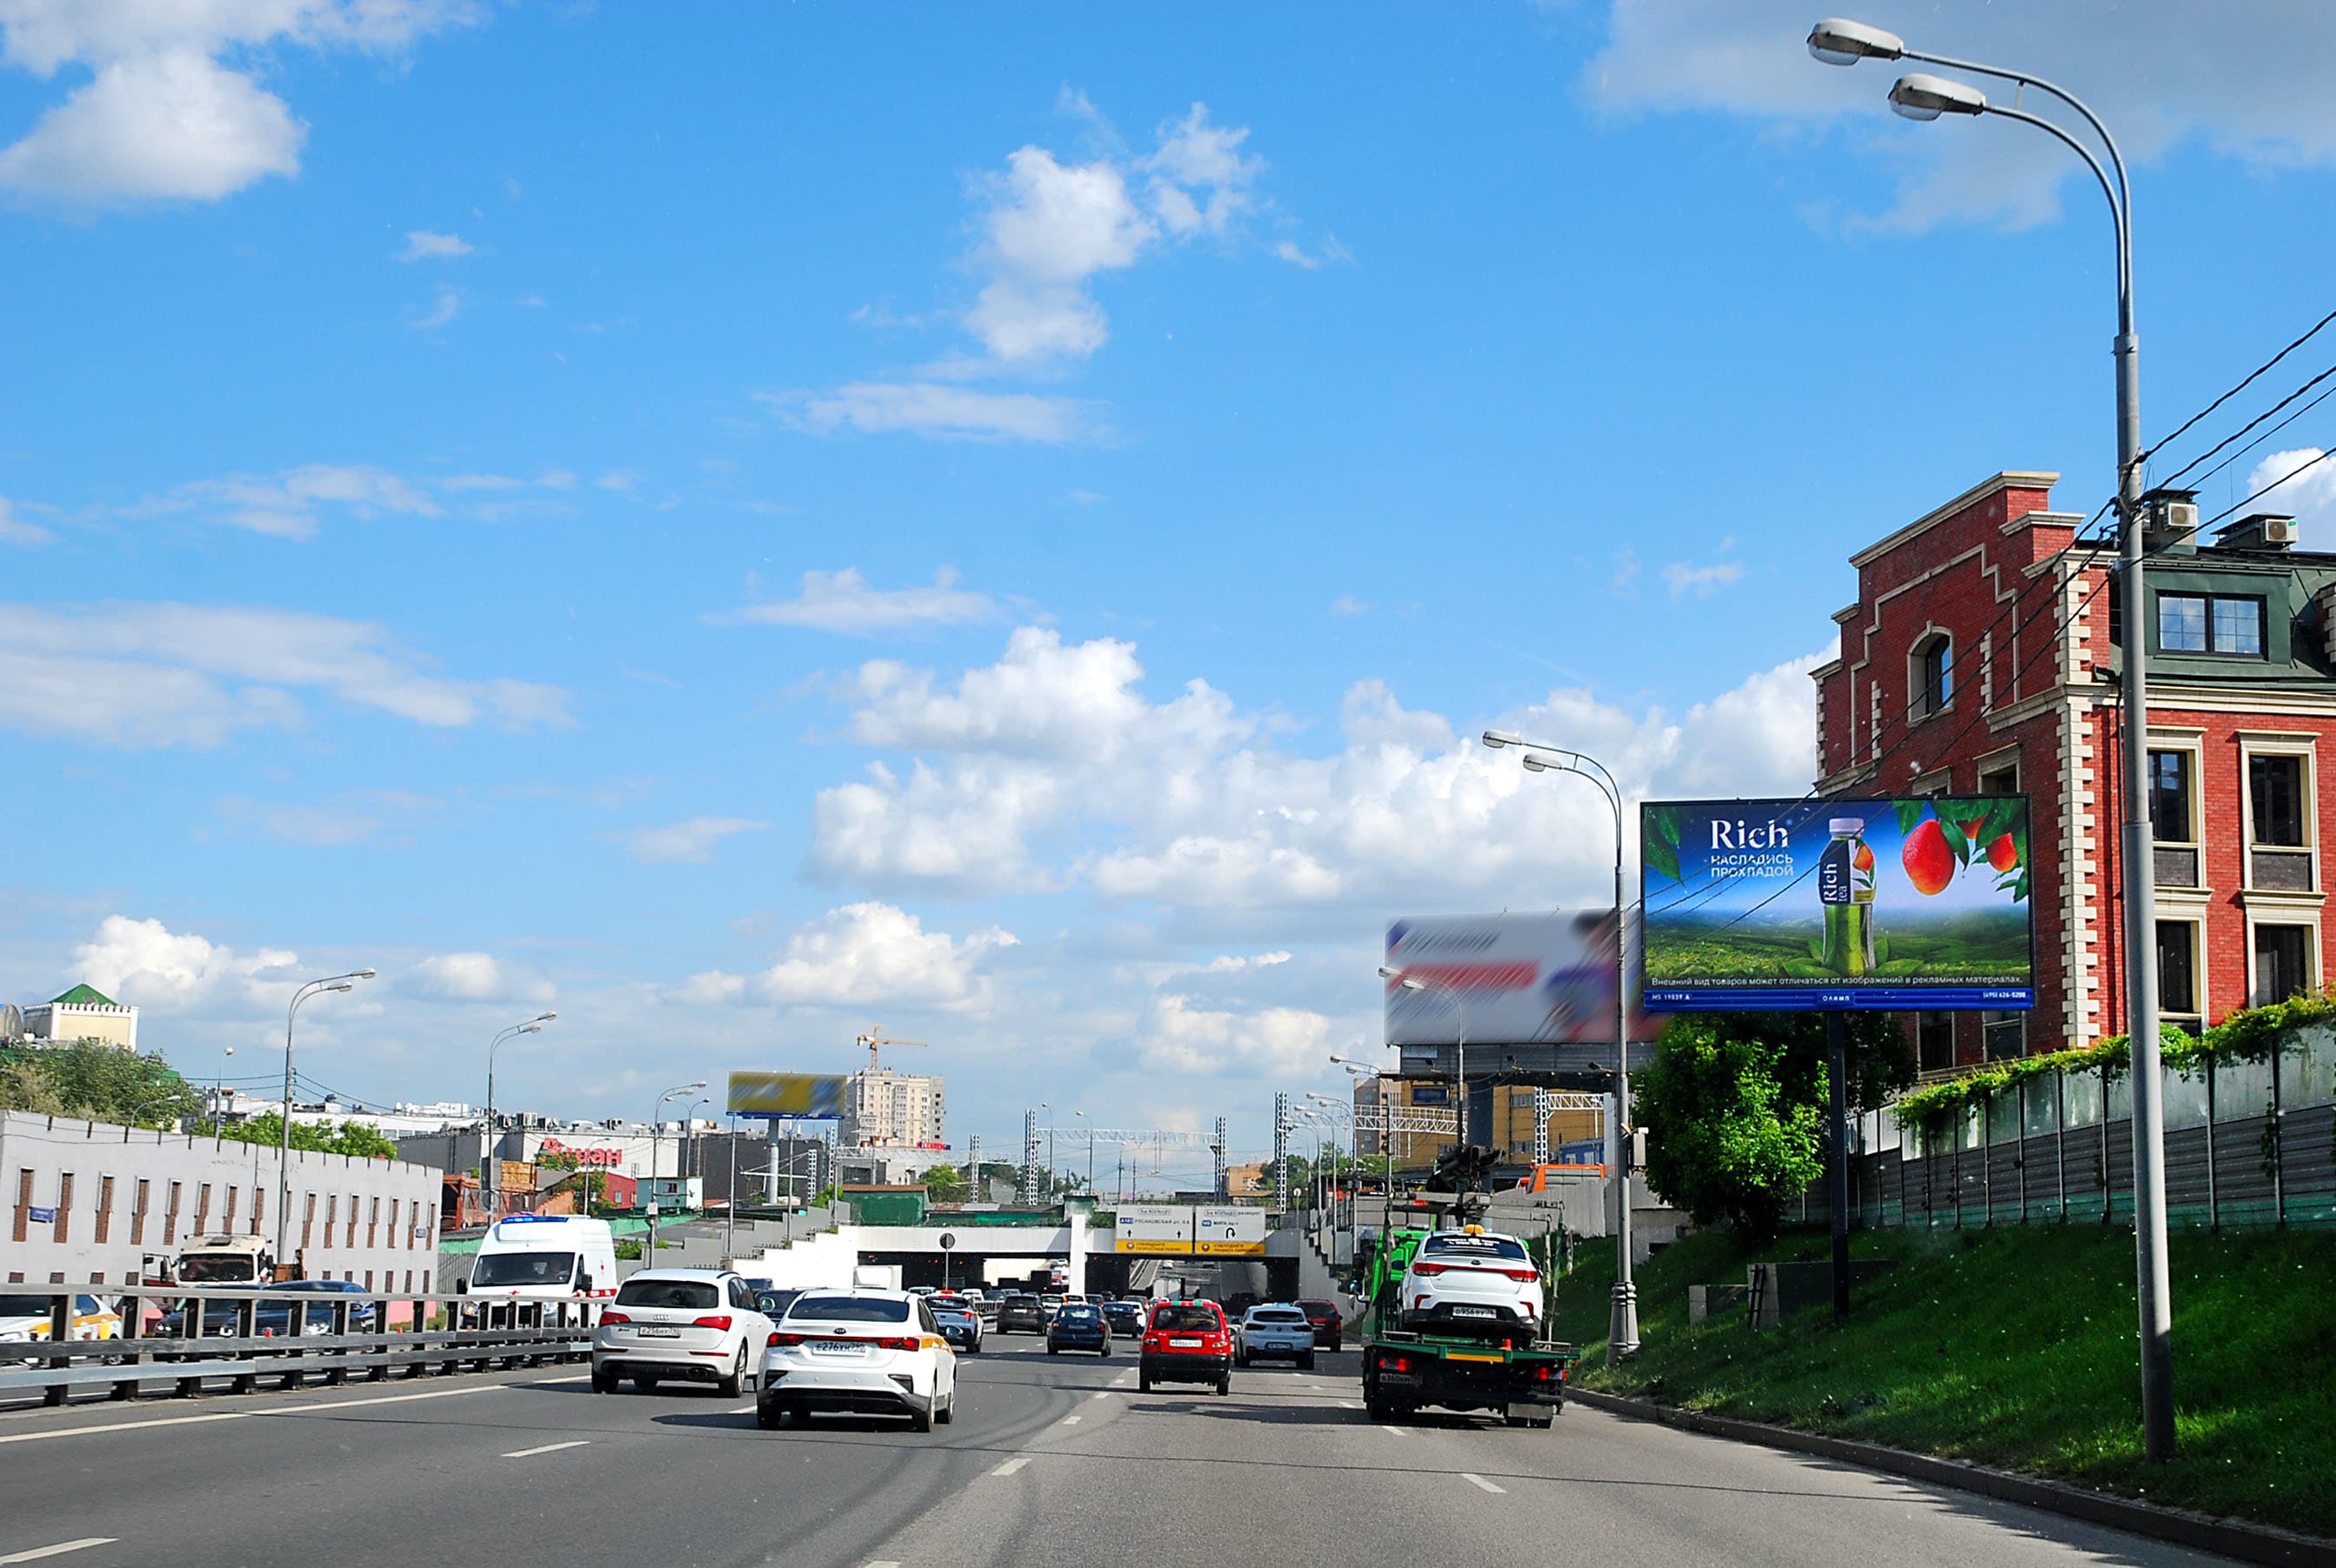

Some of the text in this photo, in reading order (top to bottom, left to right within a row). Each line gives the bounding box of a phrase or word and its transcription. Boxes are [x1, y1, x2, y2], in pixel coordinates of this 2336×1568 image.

[1711, 820, 1789, 849] Rich
[1711, 854, 1793, 865] НАСЛАДИСЬ
[1711, 865, 1793, 877] ПРОХЛАДОЙ
[1823, 864, 1837, 901] Rich
[1839, 885, 1847, 902] tea
[1652, 977, 1692, 986] Внешний
[1712, 978, 1747, 987] товаров
[1843, 976, 1904, 985] изображений
[1913, 976, 1963, 984] рекламных
